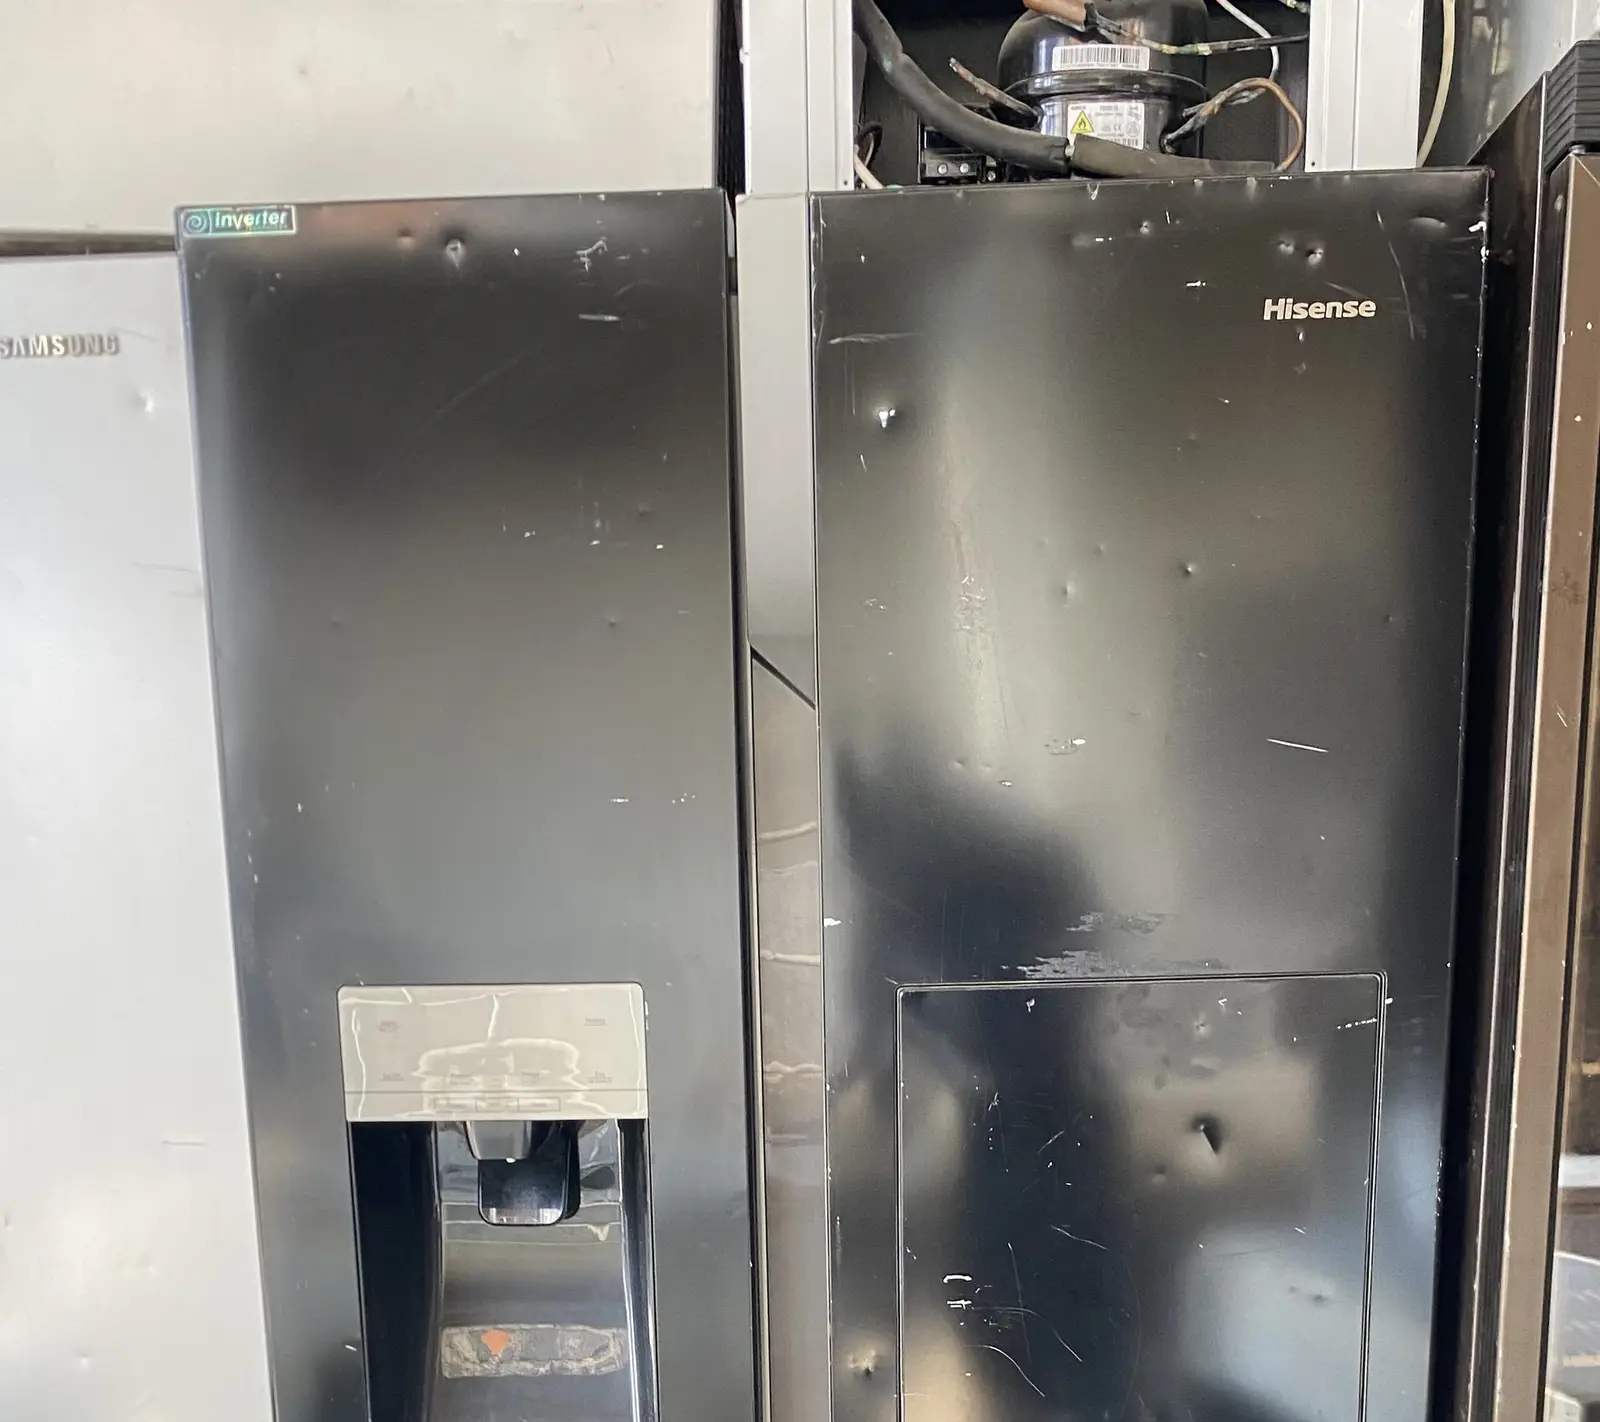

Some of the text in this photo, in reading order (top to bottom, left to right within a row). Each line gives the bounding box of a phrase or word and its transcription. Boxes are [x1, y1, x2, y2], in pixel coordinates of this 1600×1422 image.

[215, 209, 288, 230] Inverter
[1263, 298, 1377, 320] Hisense
[0, 333, 120, 358] SAMSUNG
